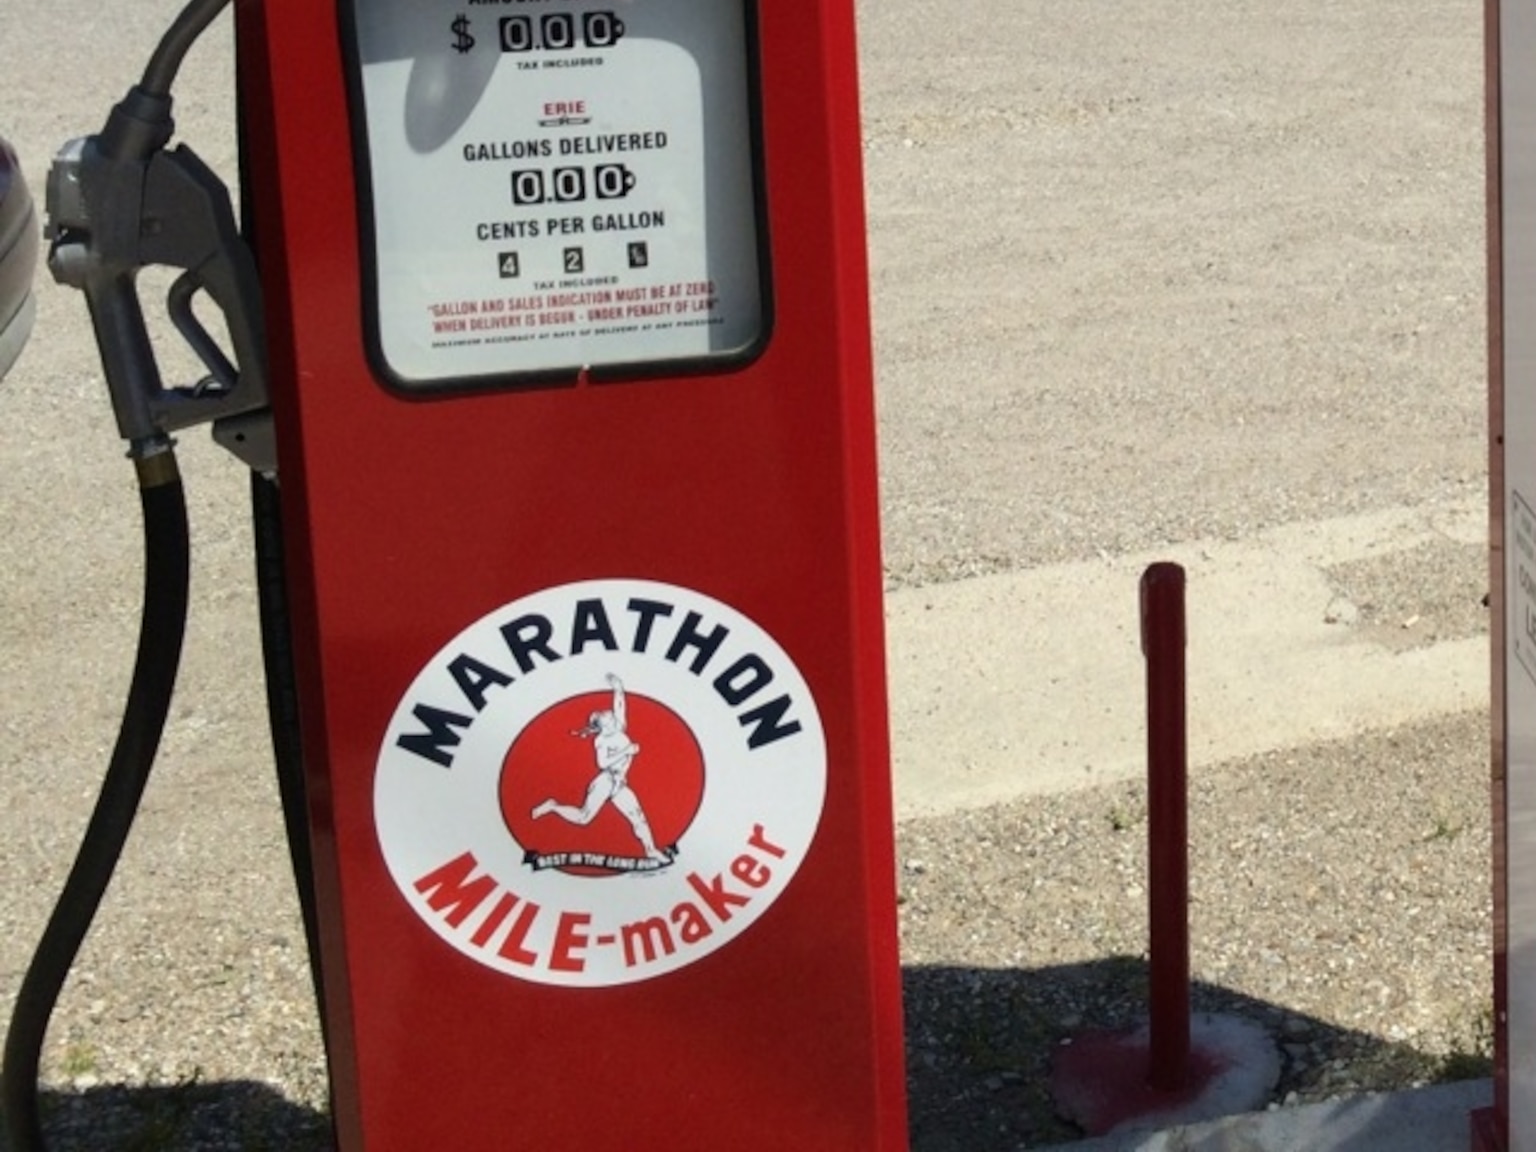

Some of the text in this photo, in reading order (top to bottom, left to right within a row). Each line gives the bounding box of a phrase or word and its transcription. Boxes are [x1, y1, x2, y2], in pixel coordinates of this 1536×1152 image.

[451, 13, 475, 54] $
[517, 56, 604, 70] TAX INCLUDED
[543, 100, 586, 116] ERIE
[463, 131, 668, 161] GALLONS DELIVERED
[477, 211, 665, 241] CENTS PER GALLON
[499, 249, 582, 277] 4 2
[481, 298, 504, 313] AND
[508, 295, 543, 311] SALES
[547, 290, 611, 308] INDICATION
[615, 287, 646, 302] MUST
[650, 285, 665, 299] BE
[669, 283, 682, 297] AT
[686, 281, 715, 296] ZERO
[534, 276, 618, 290] TAX INCLUDED
[433, 319, 466, 333] WHEN
[470, 315, 521, 331] DELIVERY
[525, 313, 536, 327] IS
[587, 306, 624, 321] UNDER
[626, 302, 671, 317] PENALTY
[674, 300, 688, 313] OF
[396, 598, 802, 769] MARATHON
[584, 853, 605, 866] THE
[413, 823, 786, 972] MILE-maker
